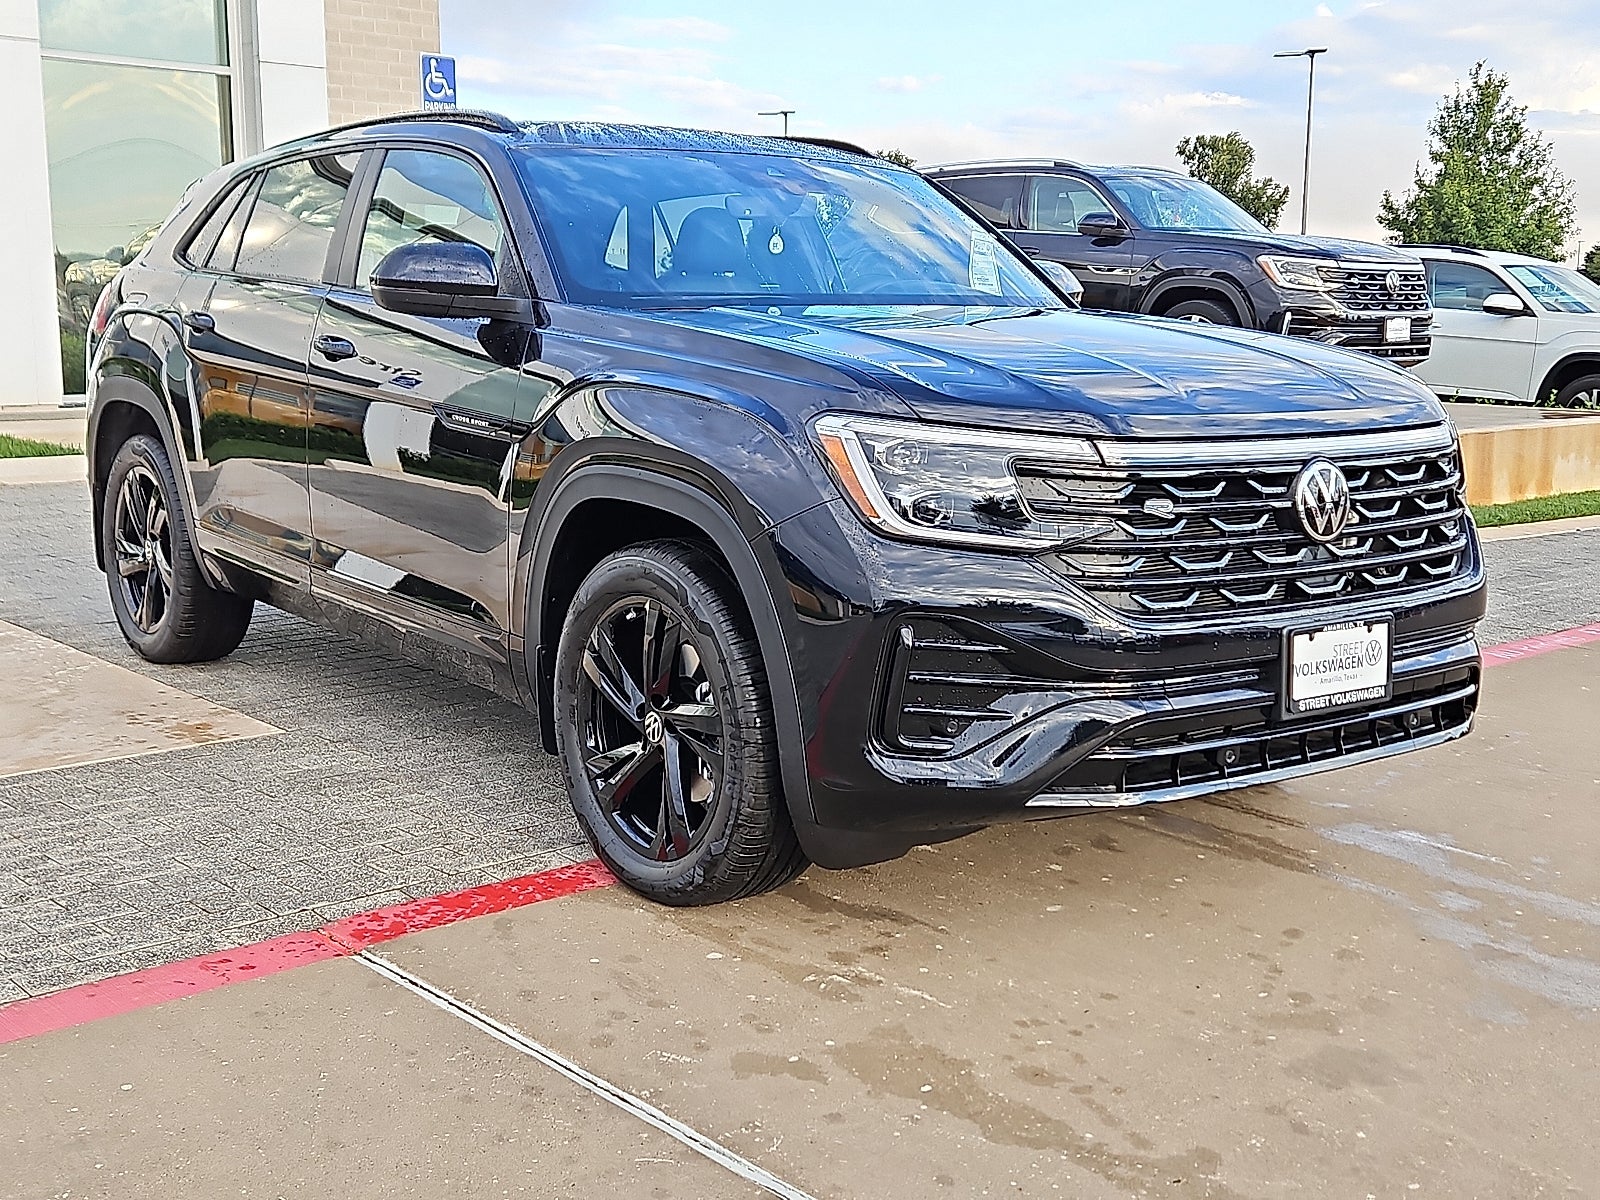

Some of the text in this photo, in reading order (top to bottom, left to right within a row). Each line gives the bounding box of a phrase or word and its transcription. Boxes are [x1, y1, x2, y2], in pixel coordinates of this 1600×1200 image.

[1333, 641, 1364, 658] STREET
[1295, 655, 1364, 677] VOLKSWAGEN
[1299, 686, 1385, 711] STREET VOLKSWAGEN
